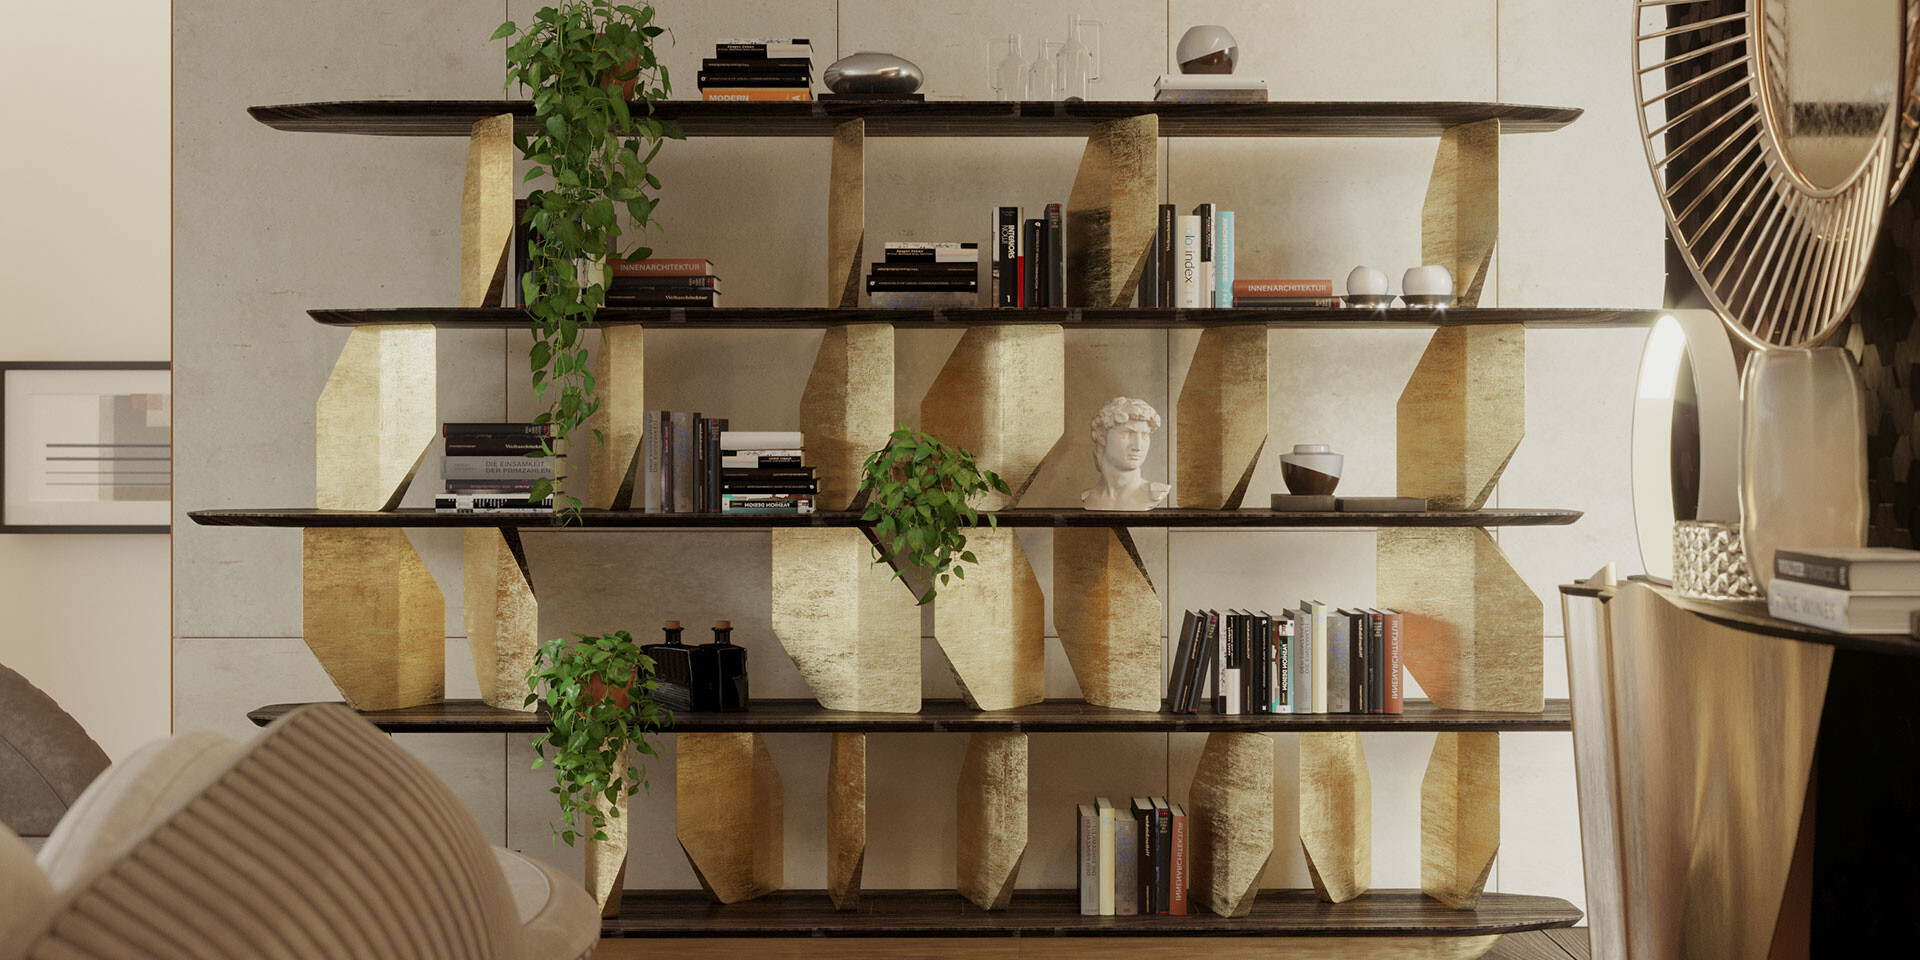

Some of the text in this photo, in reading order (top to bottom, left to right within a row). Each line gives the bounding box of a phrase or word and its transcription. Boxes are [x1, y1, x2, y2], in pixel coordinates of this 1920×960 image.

[1008, 224, 1016, 259] INTERIORS
[620, 263, 700, 271] INNENARCHITEKTUR
[1248, 284, 1327, 292] INNENARCHITEKTUR
